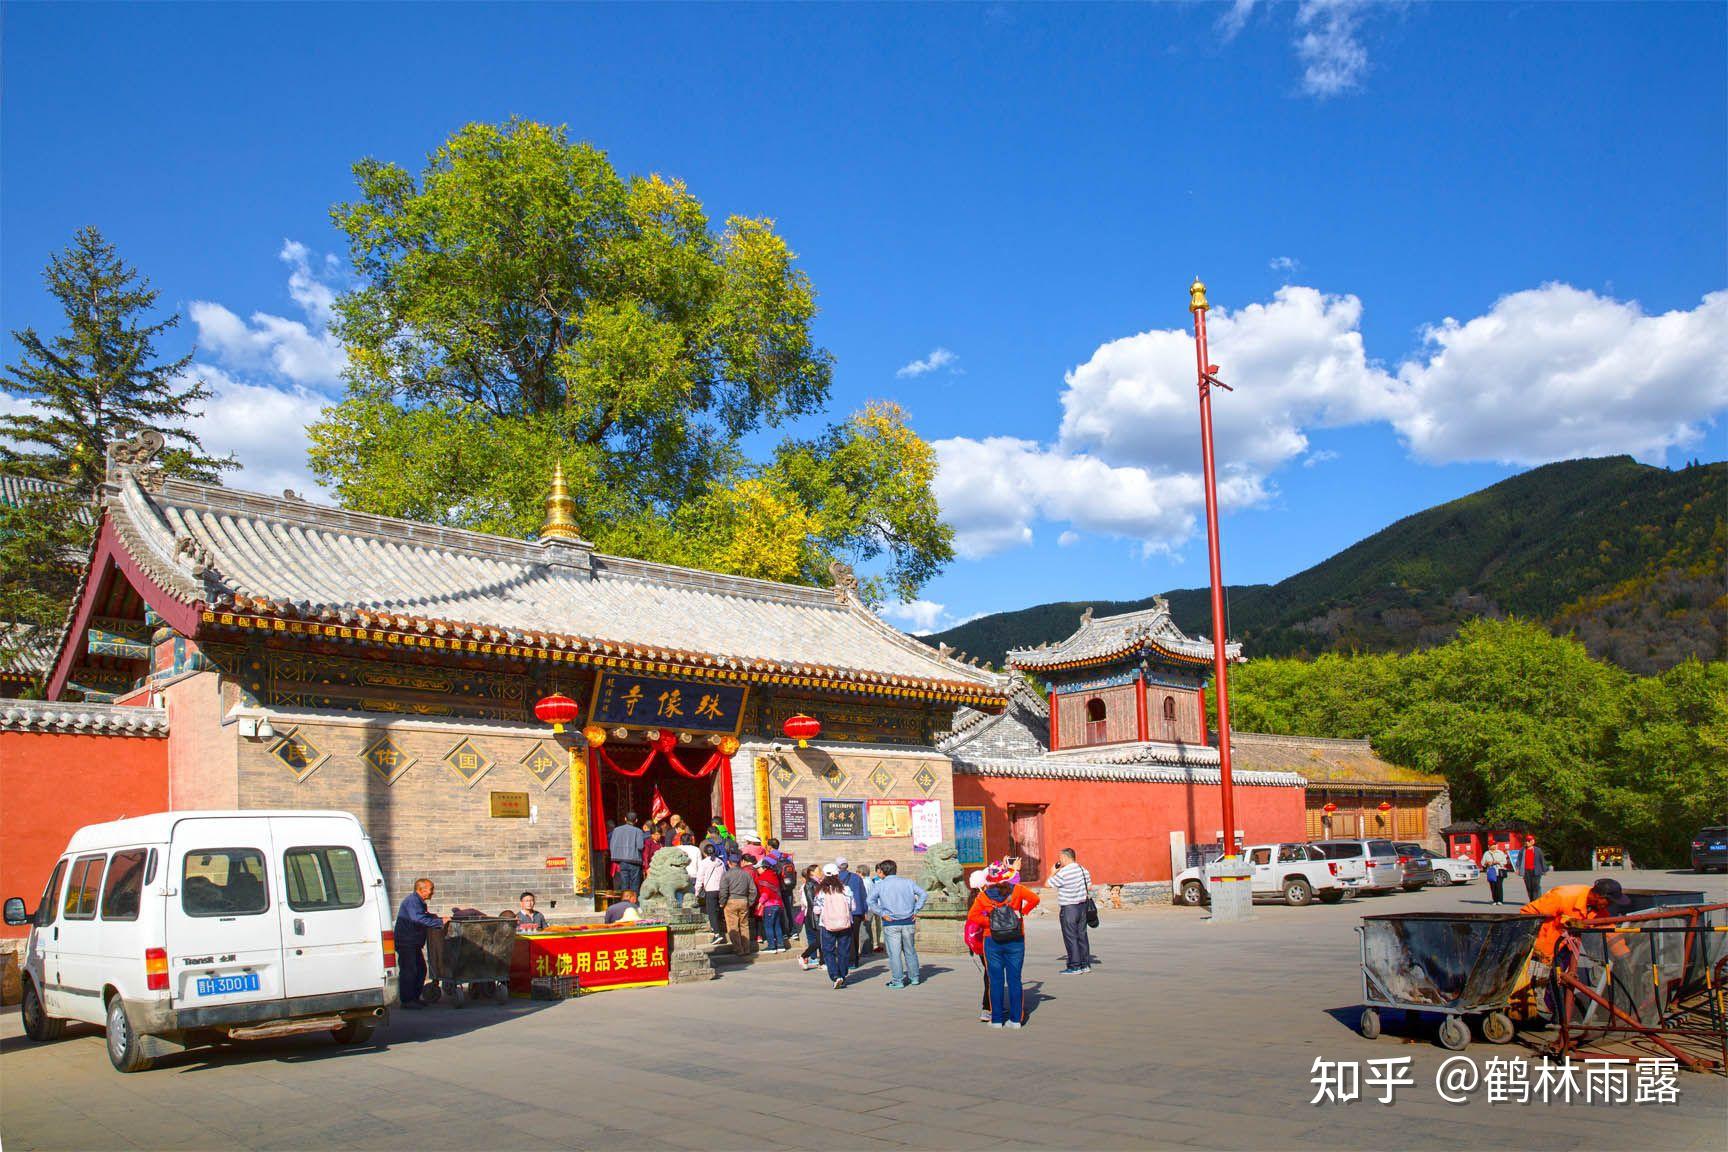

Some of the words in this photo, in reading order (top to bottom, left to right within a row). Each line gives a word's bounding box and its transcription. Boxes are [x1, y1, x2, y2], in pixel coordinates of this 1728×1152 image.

[287, 744, 313, 764] 民
[374, 748, 399, 765] 佑
[459, 753, 478, 769] 国
[533, 757, 553, 773] 护
[920, 773, 932, 786] 法
[536, 946, 666, 977] 礼佛用品受理点
